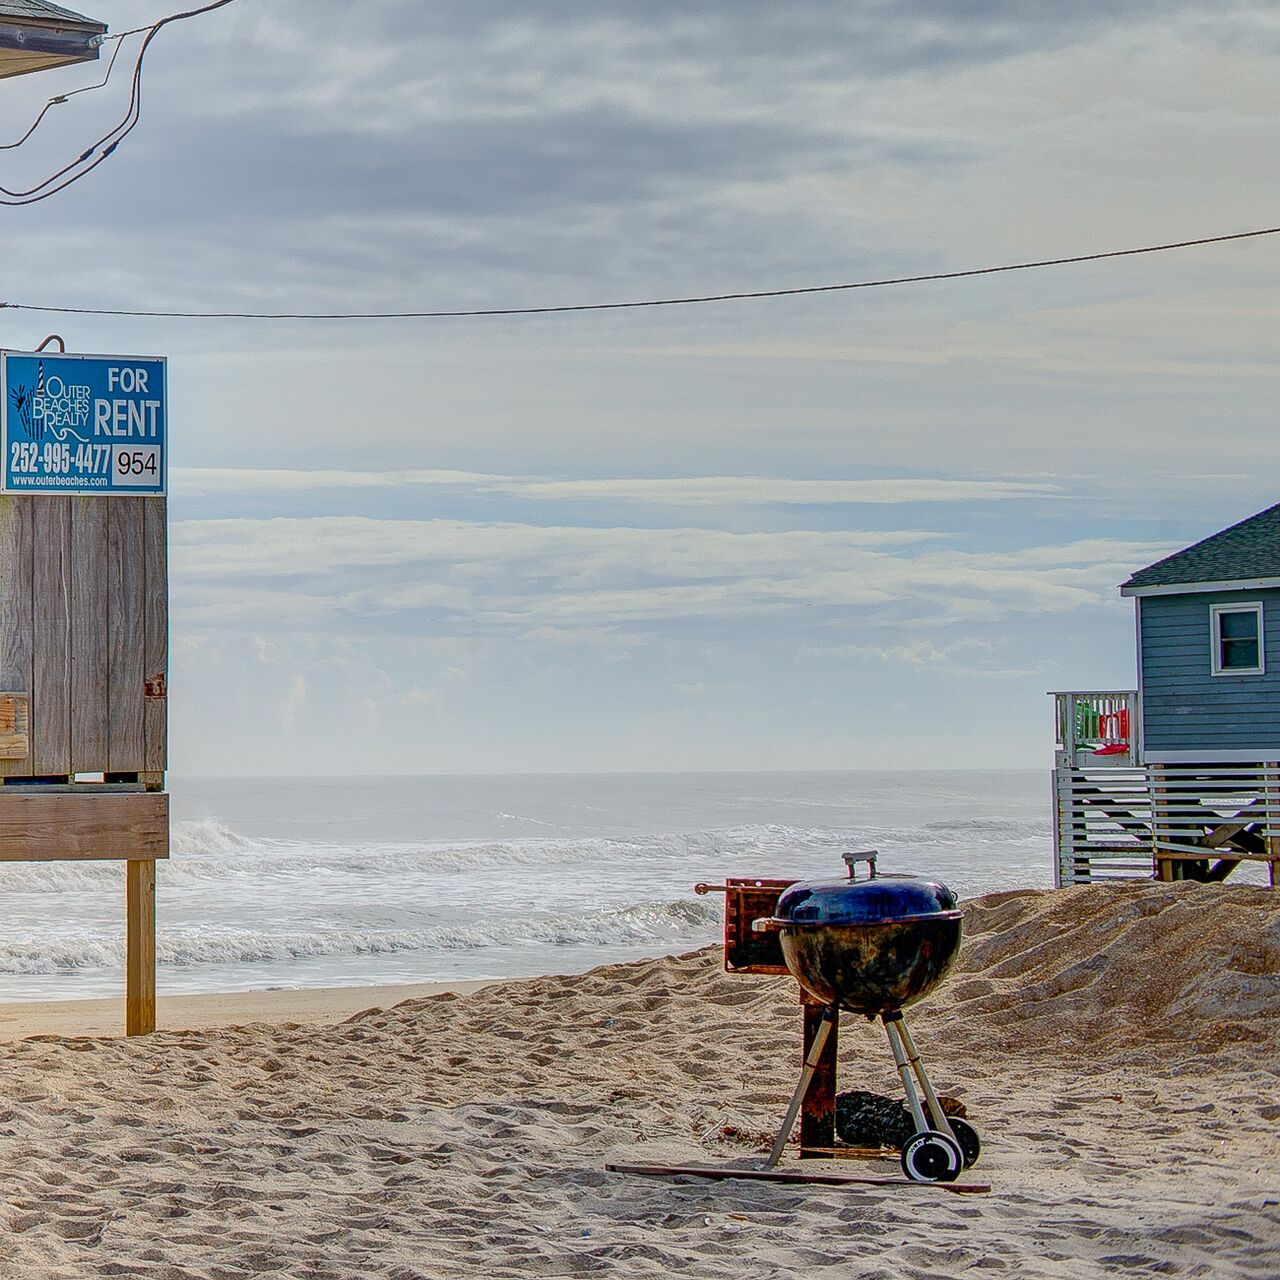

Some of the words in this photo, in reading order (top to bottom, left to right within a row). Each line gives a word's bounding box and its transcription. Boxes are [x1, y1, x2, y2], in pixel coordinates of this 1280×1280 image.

[46, 376, 90, 399] OUTER
[108, 368, 149, 393] FOR
[33, 398, 89, 419] BEACHES
[94, 399, 160, 437] RENT
[44, 412, 89, 434] REALTY
[11, 441, 111, 474] 252-995-4477
[118, 452, 157, 475] 954
[13, 476, 108, 487] www.outerbeaches.com
